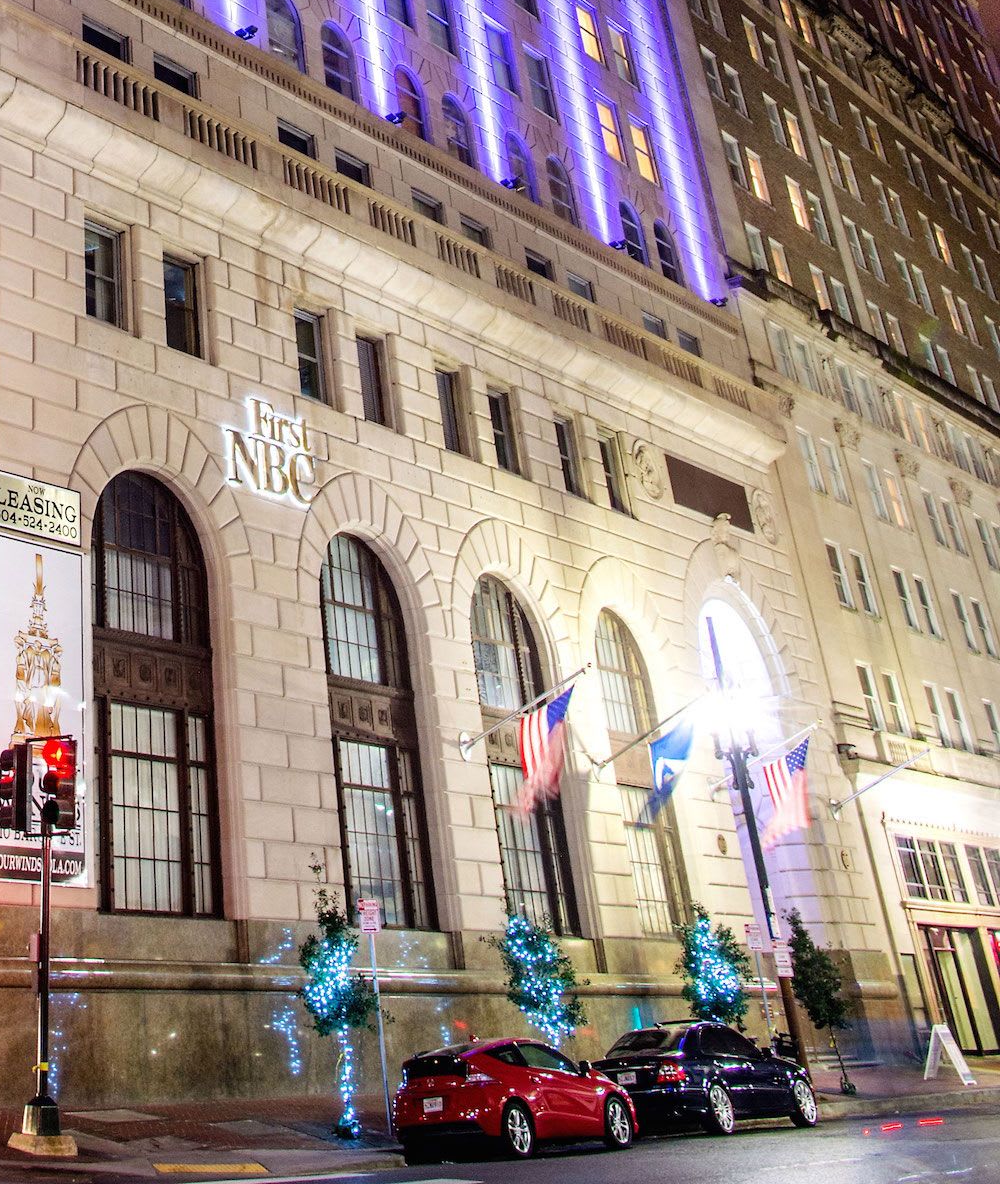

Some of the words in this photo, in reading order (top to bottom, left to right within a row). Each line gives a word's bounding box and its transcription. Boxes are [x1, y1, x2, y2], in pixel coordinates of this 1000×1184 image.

[249, 397, 312, 452] First
[28, 484, 46, 496] NOW
[225, 428, 314, 504] NBC
